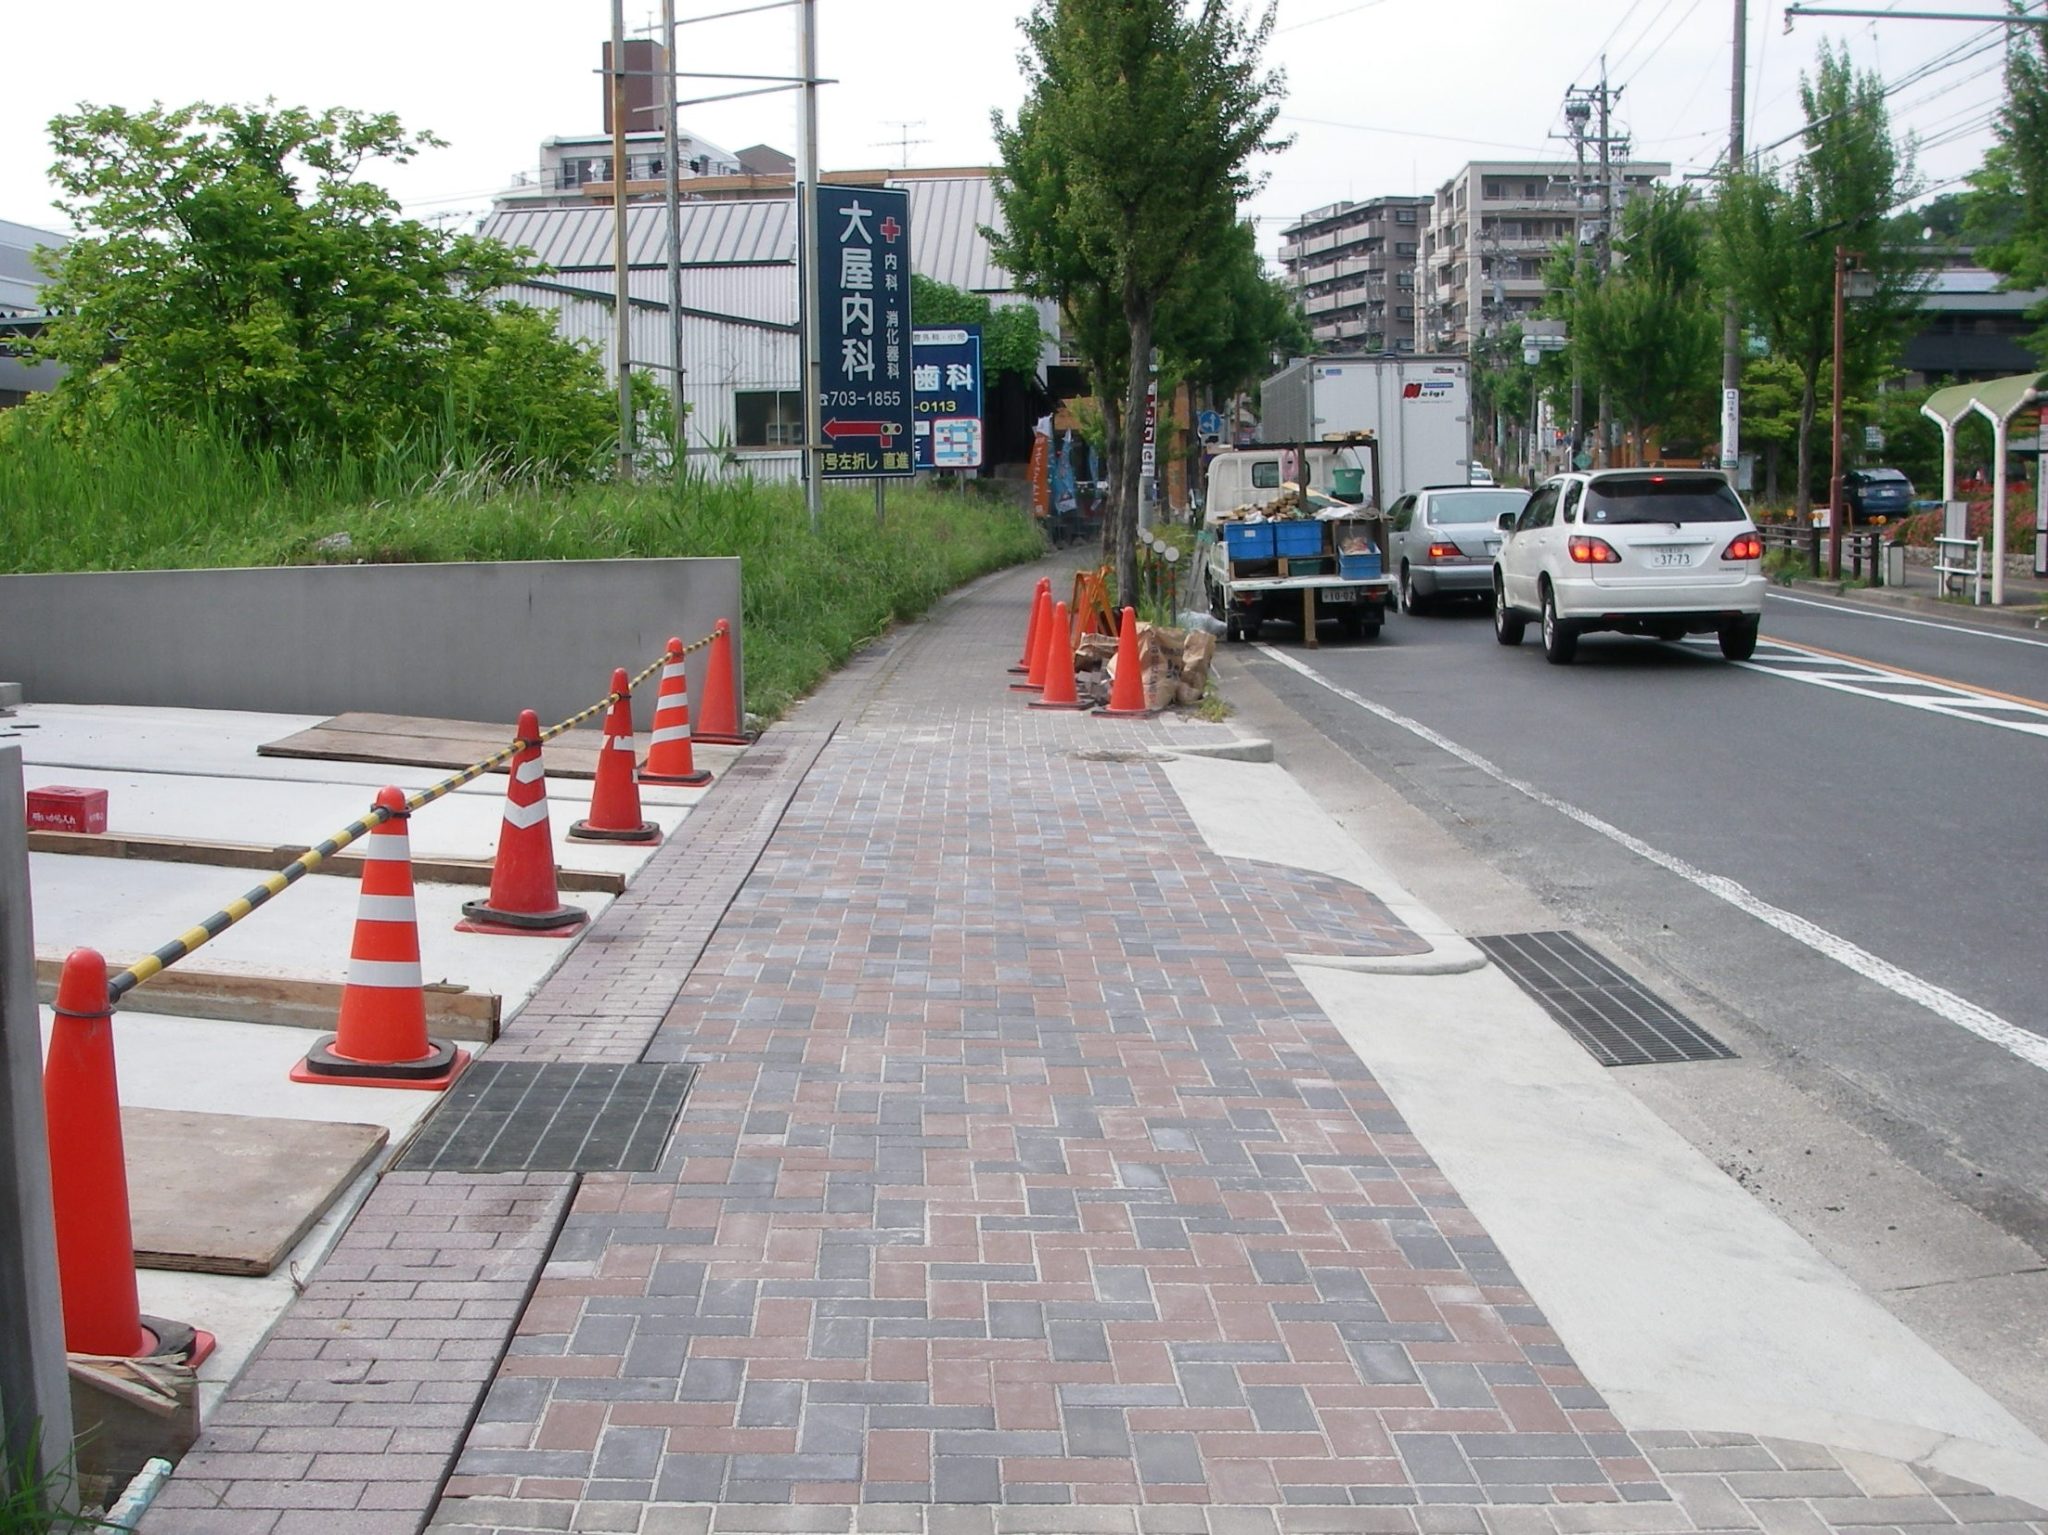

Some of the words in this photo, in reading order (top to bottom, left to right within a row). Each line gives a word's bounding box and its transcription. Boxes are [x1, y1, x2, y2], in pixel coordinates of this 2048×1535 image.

[839, 200, 875, 382] 大屋内科
[884, 253, 900, 380] 内科・消化器科
[830, 391, 901, 406] 703-1855
[883, 452, 910, 470] 直進
